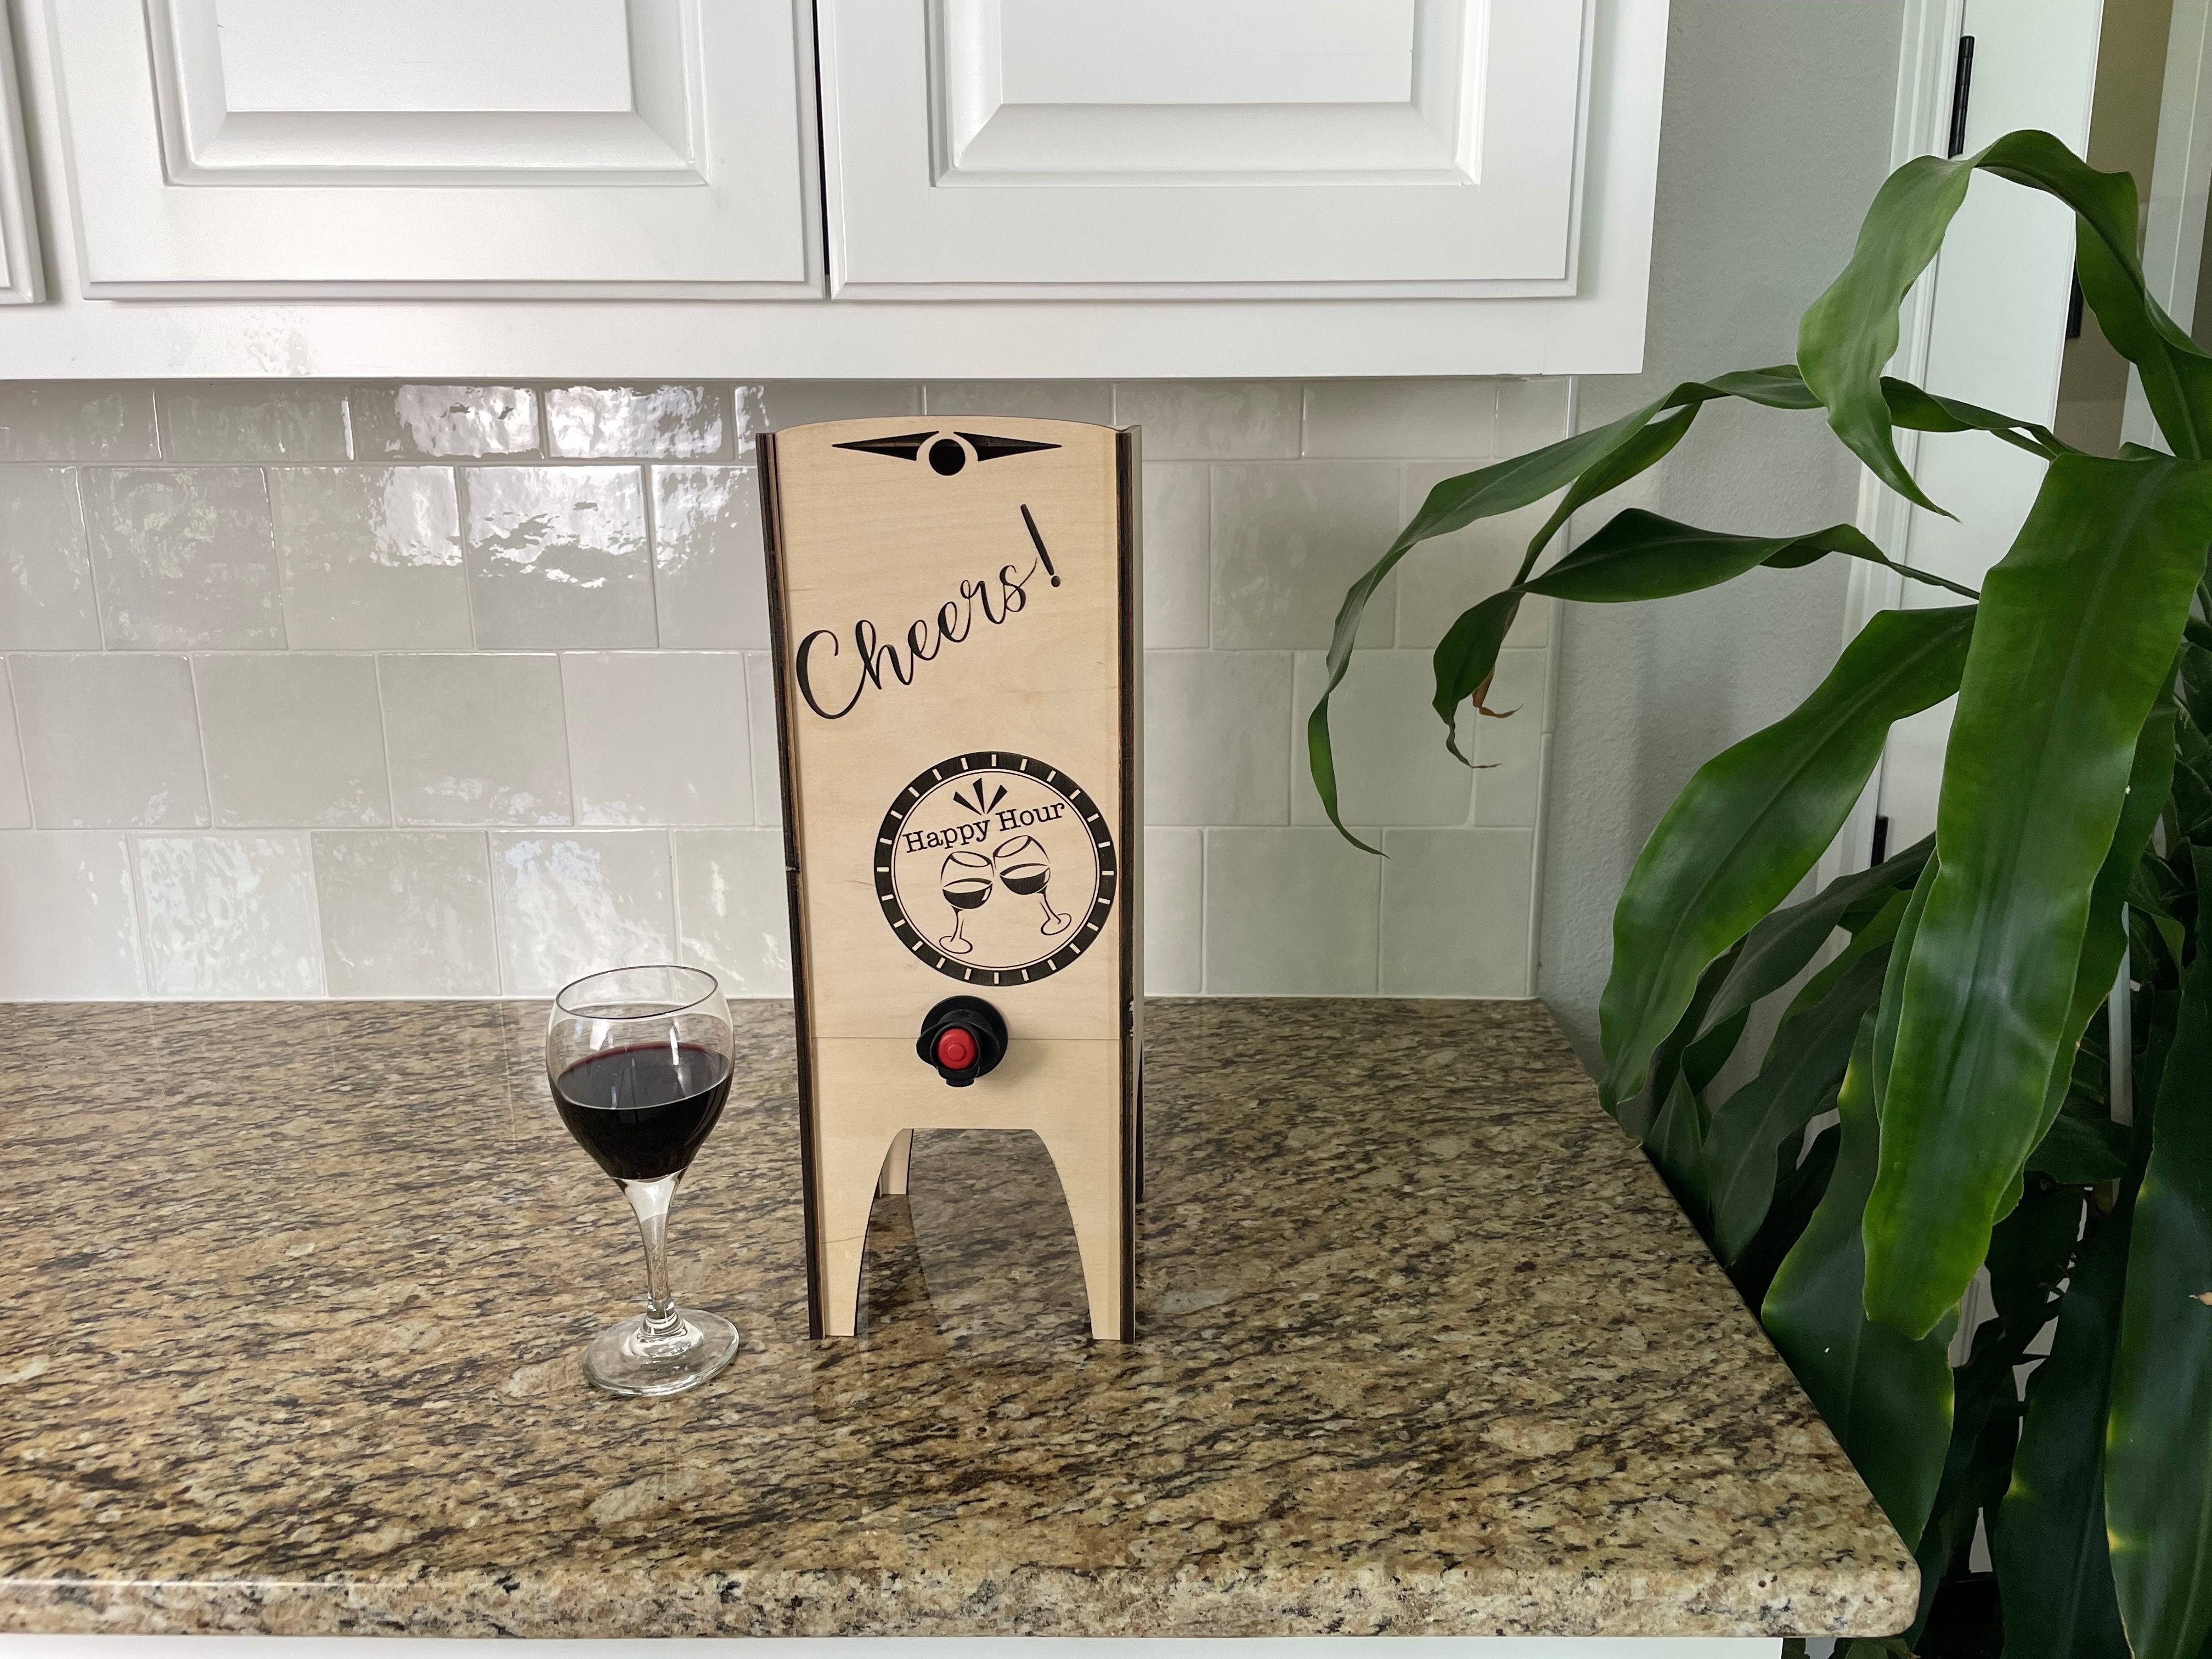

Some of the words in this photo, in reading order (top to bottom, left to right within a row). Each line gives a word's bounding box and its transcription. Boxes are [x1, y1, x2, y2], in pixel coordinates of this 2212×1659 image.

[796, 504, 1060, 719] Cheers!
[902, 819, 991, 854] Happy
[995, 802, 1065, 832] Hour
